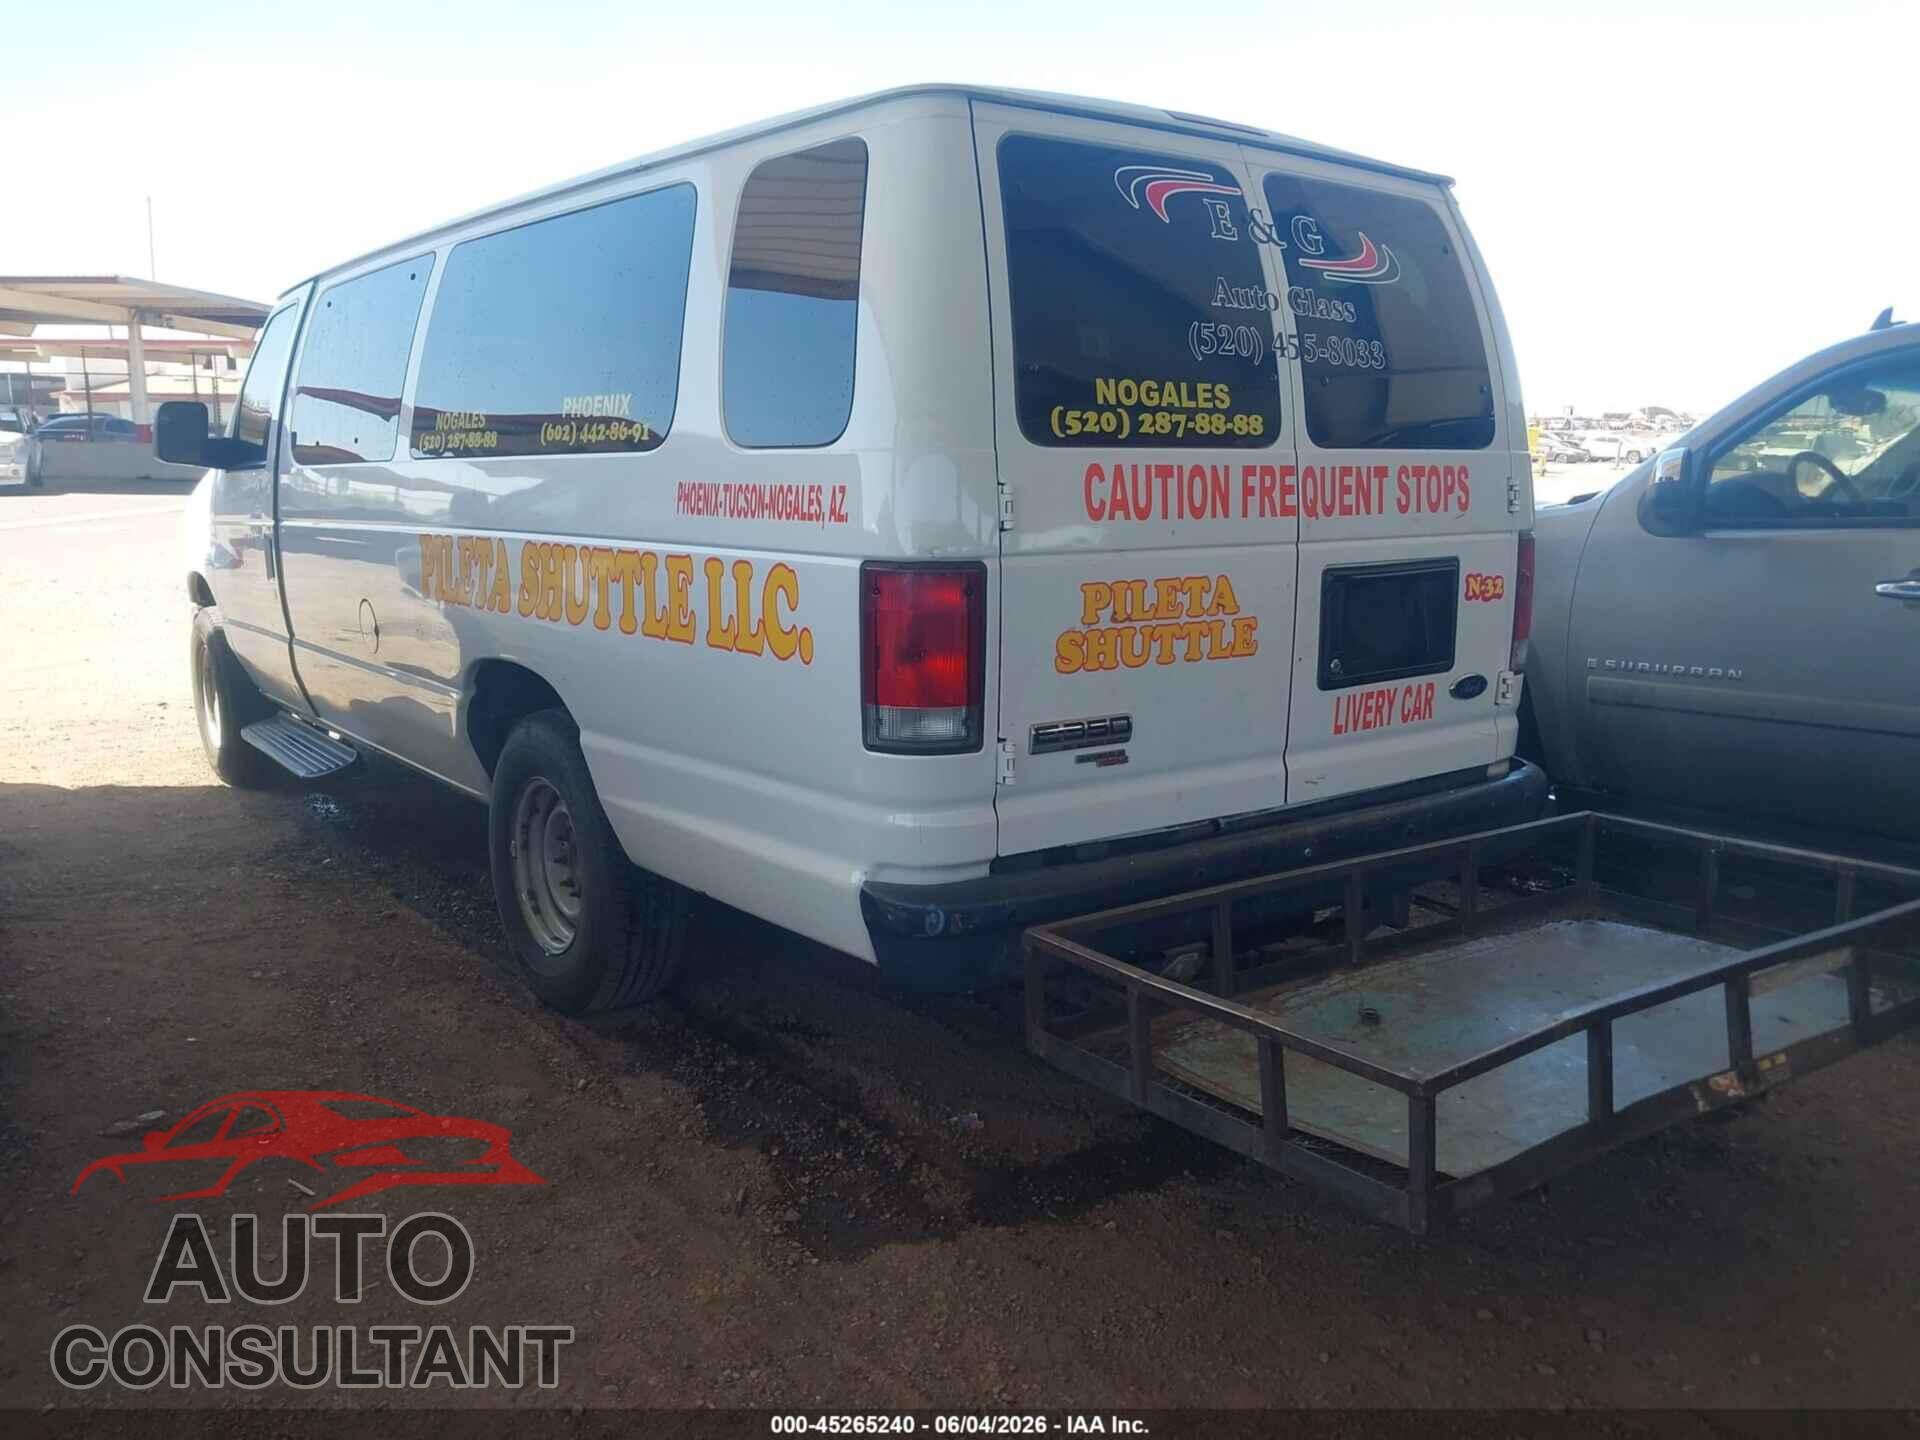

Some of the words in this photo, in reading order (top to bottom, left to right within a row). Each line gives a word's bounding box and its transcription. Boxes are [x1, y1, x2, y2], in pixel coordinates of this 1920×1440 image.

[1203, 198, 1238, 241] E
[1248, 208, 1287, 249] &
[1291, 215, 1325, 255] G
[1211, 277, 1280, 312] Auto
[1286, 286, 1357, 322] Glass
[1188, 321, 1264, 366] (520)
[1272, 332, 1386, 370] 455-8033
[561, 393, 633, 419] PHOENIX
[1095, 377, 1231, 409] NOGALES
[435, 411, 486, 432] NOGALES
[540, 421, 577, 446] (602)
[579, 421, 651, 444] 442-86-91
[1050, 406, 1131, 439] (520)
[1138, 408, 1264, 439] 287-88-88
[676, 481, 825, 530] PHOENIX-TUCSON-NOGALES,
[828, 485, 848, 523] AZ.
[1083, 463, 1230, 521] CAUTION
[1241, 464, 1389, 519] FREQUENT
[1396, 465, 1470, 515] STOPS
[418, 533, 511, 614] PILETA
[517, 540, 697, 645] SHUTTLE
[703, 556, 814, 666] LLC.
[1080, 575, 1240, 625] PILETA
[1054, 616, 1257, 674] SHUTTLE
[1604, 658, 1743, 680] SUBURBAN
[1332, 686, 1399, 735] LIVERY
[1400, 682, 1435, 721] CAR
